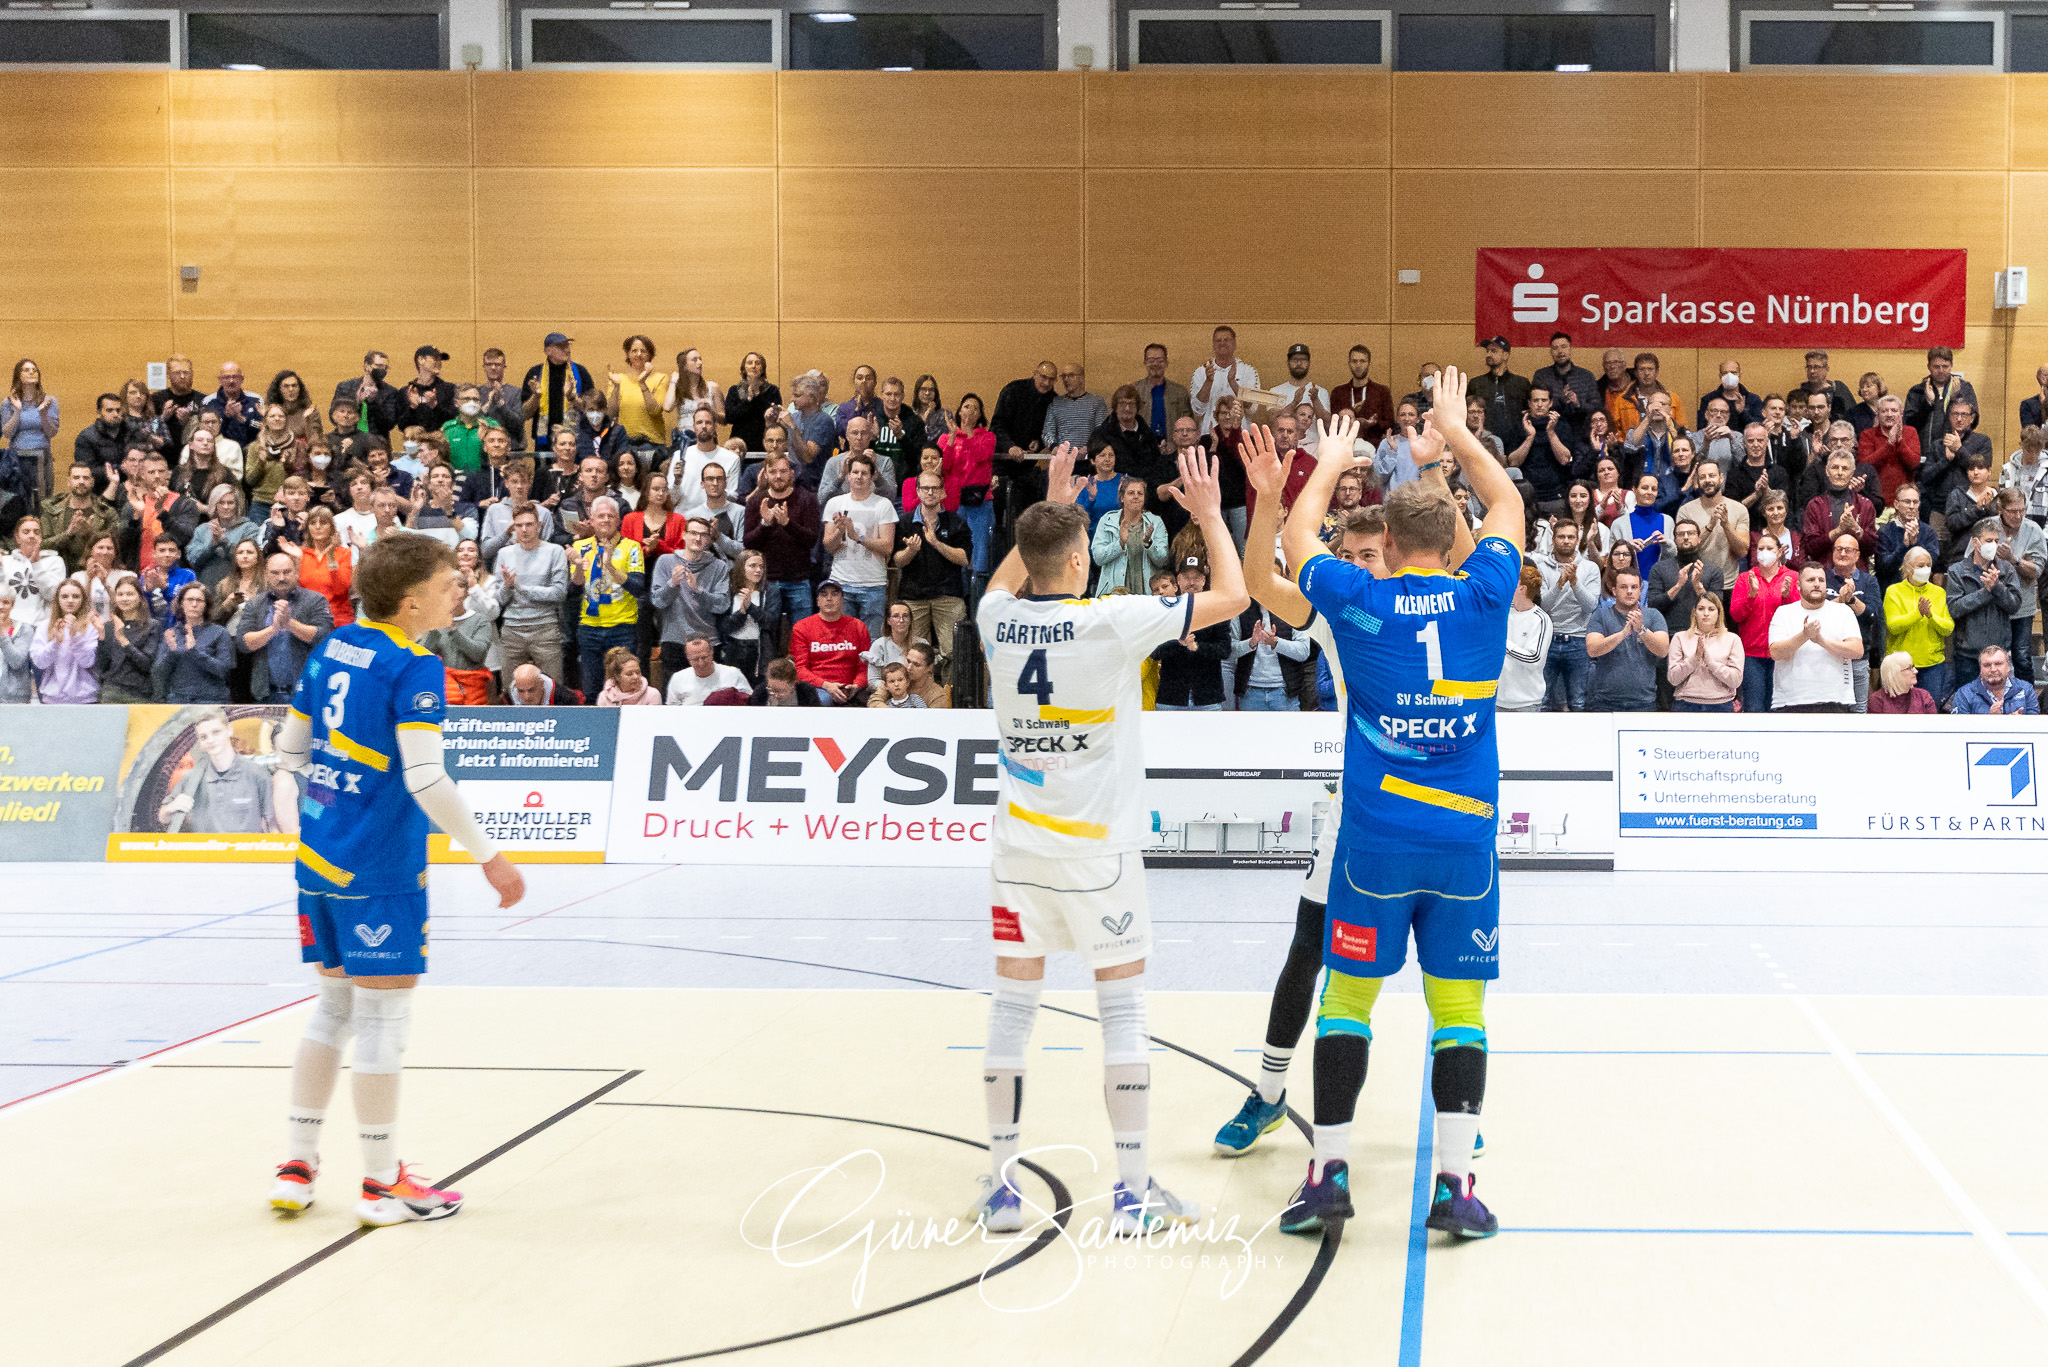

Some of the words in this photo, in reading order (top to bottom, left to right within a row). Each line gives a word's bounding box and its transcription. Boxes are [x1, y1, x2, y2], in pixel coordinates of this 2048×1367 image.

[1581, 293, 1755, 330] Sparkasse
[1767, 293, 1930, 332] Nürnberg
[1394, 591, 1456, 616] KLEMENT
[996, 619, 1075, 644] GÄRTNER
[810, 640, 857, 653] Bench.
[1416, 620, 1443, 680] 1
[1017, 649, 1053, 705] 4
[322, 671, 350, 729] 3
[1396, 693, 1412, 706] SV
[1414, 692, 1464, 706] Schwaig
[440, 718, 557, 736] kräftemangel?
[1026, 717, 1070, 730] Schwaig
[1379, 715, 1457, 738] SPECK
[441, 736, 590, 753] erbundausbildung!
[456, 754, 496, 768] Jetzt
[500, 754, 599, 768] informieren!
[1654, 748, 1759, 762] Steuerberatung
[0, 771, 105, 792] zwerken
[1654, 770, 1782, 784] Wirtschaftsprüfung
[1654, 791, 1817, 806] Unternehmensberatung
[643, 812, 753, 839] Druck
[804, 814, 995, 842] Werbetec
[1655, 814, 1803, 829] www.fuerst-beratung.de
[1868, 812, 1941, 831] FÜRST
[485, 827, 578, 840] SERVICES
